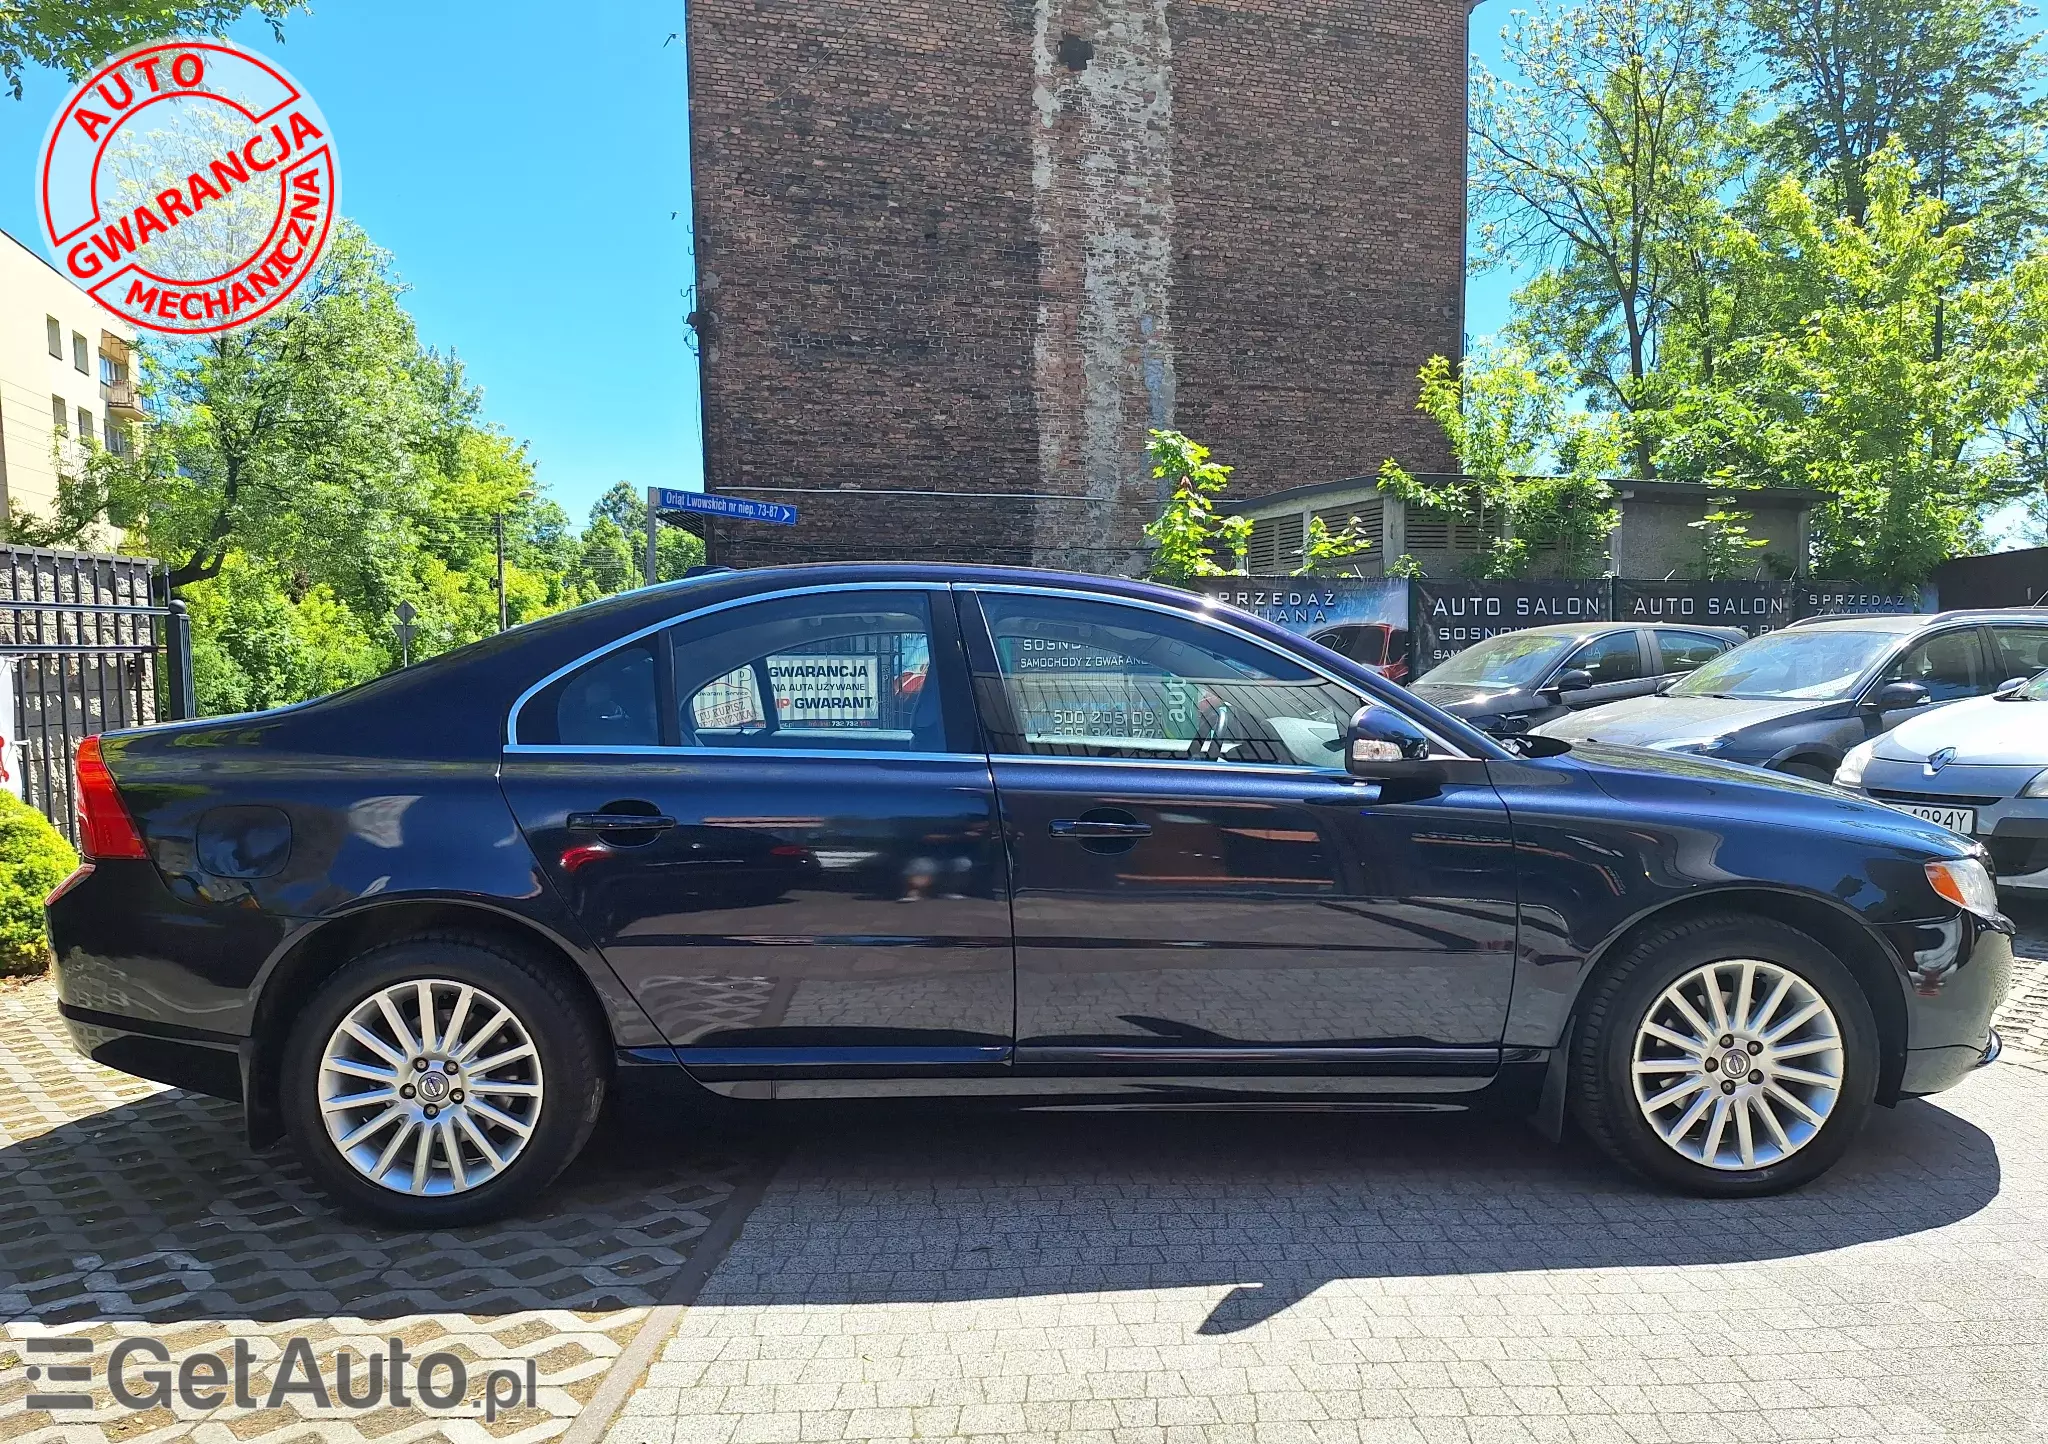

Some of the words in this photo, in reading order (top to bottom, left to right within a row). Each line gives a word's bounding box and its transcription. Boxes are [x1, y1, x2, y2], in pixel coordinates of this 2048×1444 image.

[666, 491, 685, 509] Orląt
[686, 495, 727, 511] Lwowskich
[728, 503, 737, 512] nr
[738, 503, 756, 518] niep.
[757, 504, 779, 518] 73-87
[1204, 590, 1335, 606] PRZEDAŻ
[1432, 597, 1501, 616] AUTO
[1516, 597, 1600, 616] SALON
[1632, 597, 1694, 616] AUTO
[1708, 597, 1784, 616] SALON
[1020, 657, 1083, 668] SAMOCHODY
[1085, 657, 1092, 667] Z
[768, 665, 869, 678] GWARANCJA
[773, 683, 787, 692] NA
[788, 683, 814, 692] AUTA
[816, 682, 866, 691] UŻYWANE
[795, 696, 872, 709] GWARANT
[698, 711, 711, 721] TU
[713, 701, 746, 718] KUPISZ
[1054, 710, 1085, 725] 500
[1091, 711, 1125, 726] 205
